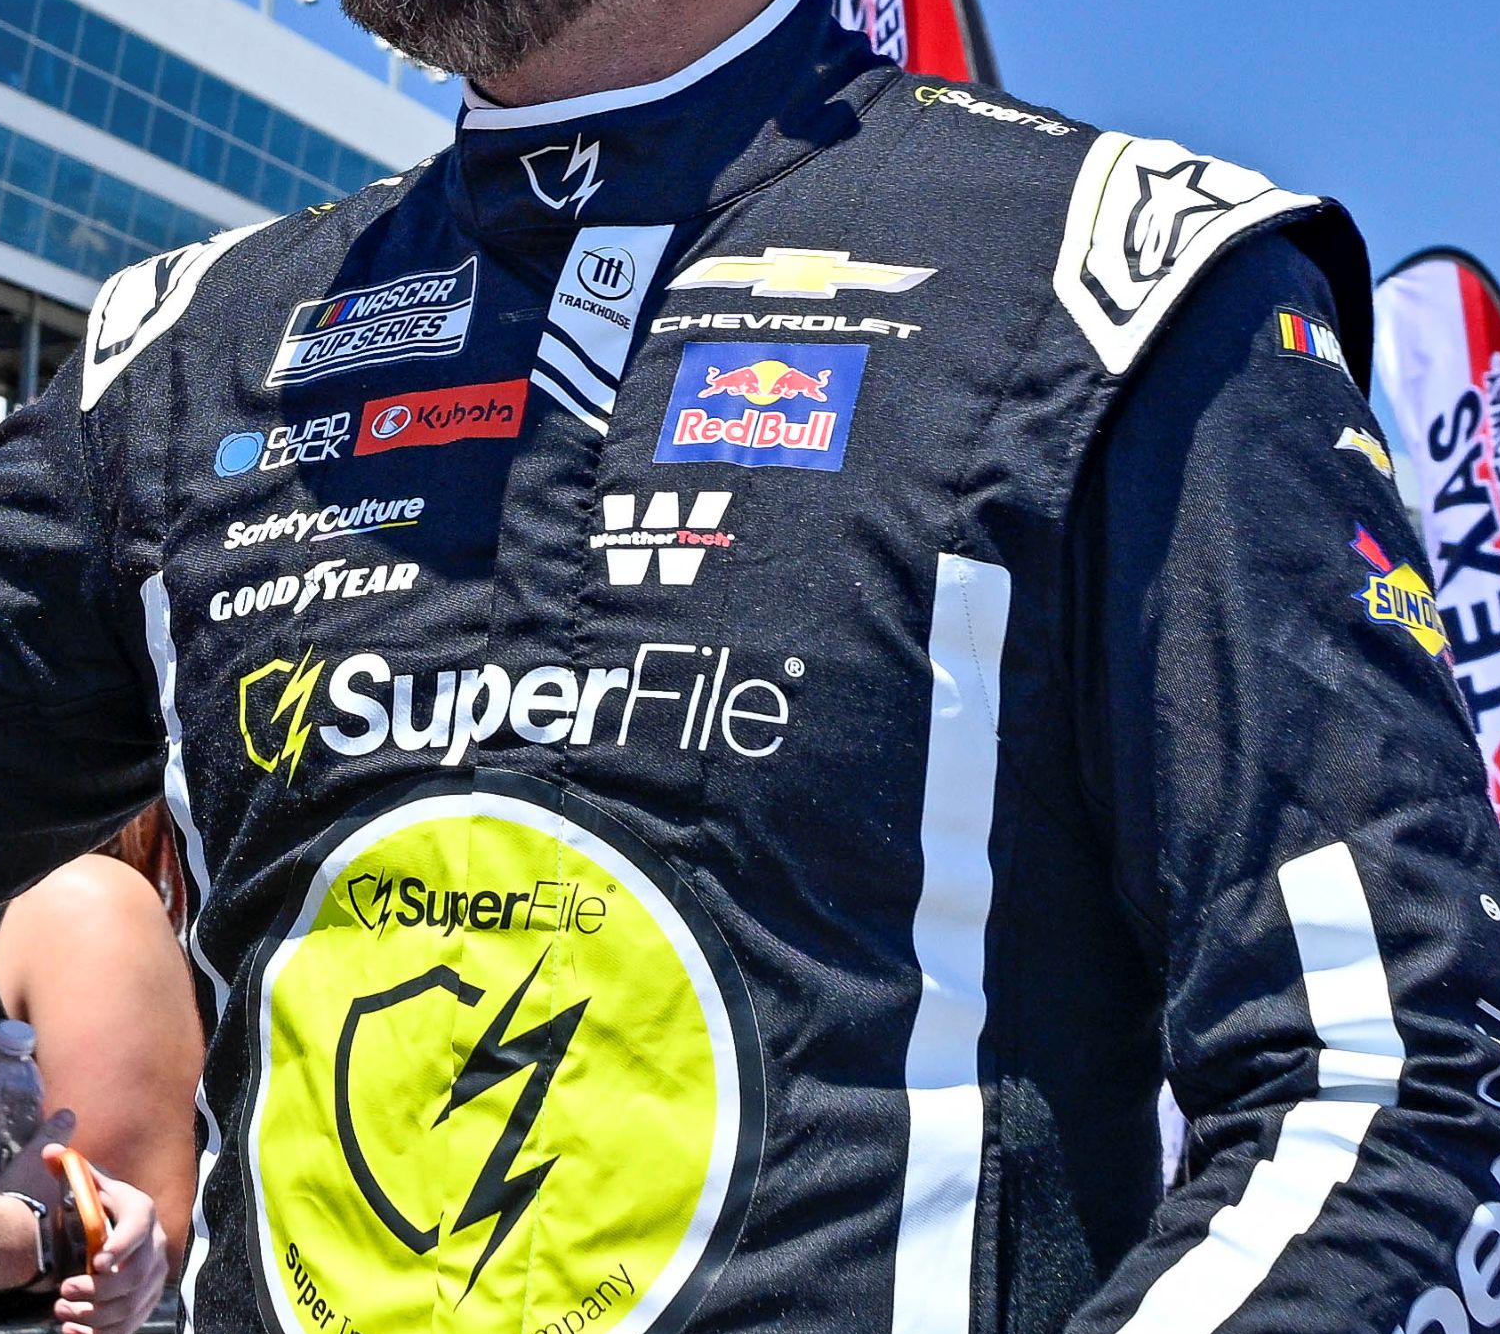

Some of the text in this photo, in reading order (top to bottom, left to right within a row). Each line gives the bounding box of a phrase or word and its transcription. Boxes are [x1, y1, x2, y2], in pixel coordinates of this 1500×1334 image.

[938, 88, 1074, 137] SuperFile
[351, 276, 458, 321] NASCAR
[558, 292, 633, 331] TRACKHOUSE
[304, 313, 449, 364] CUP SERIES
[650, 312, 922, 340] CHEVROLET
[269, 412, 351, 450] QUAD
[416, 400, 514, 429] Kubota
[677, 408, 838, 452] Red Bull
[258, 435, 343, 471] LOCK
[223, 497, 426, 550] SafetyCulture
[589, 530, 732, 549] WeatherTech
[209, 559, 421, 621] GOODYEAR
[1375, 581, 1445, 639] SUNO
[319, 643, 789, 766] SuperFile
[395, 875, 607, 940] SuperFile
